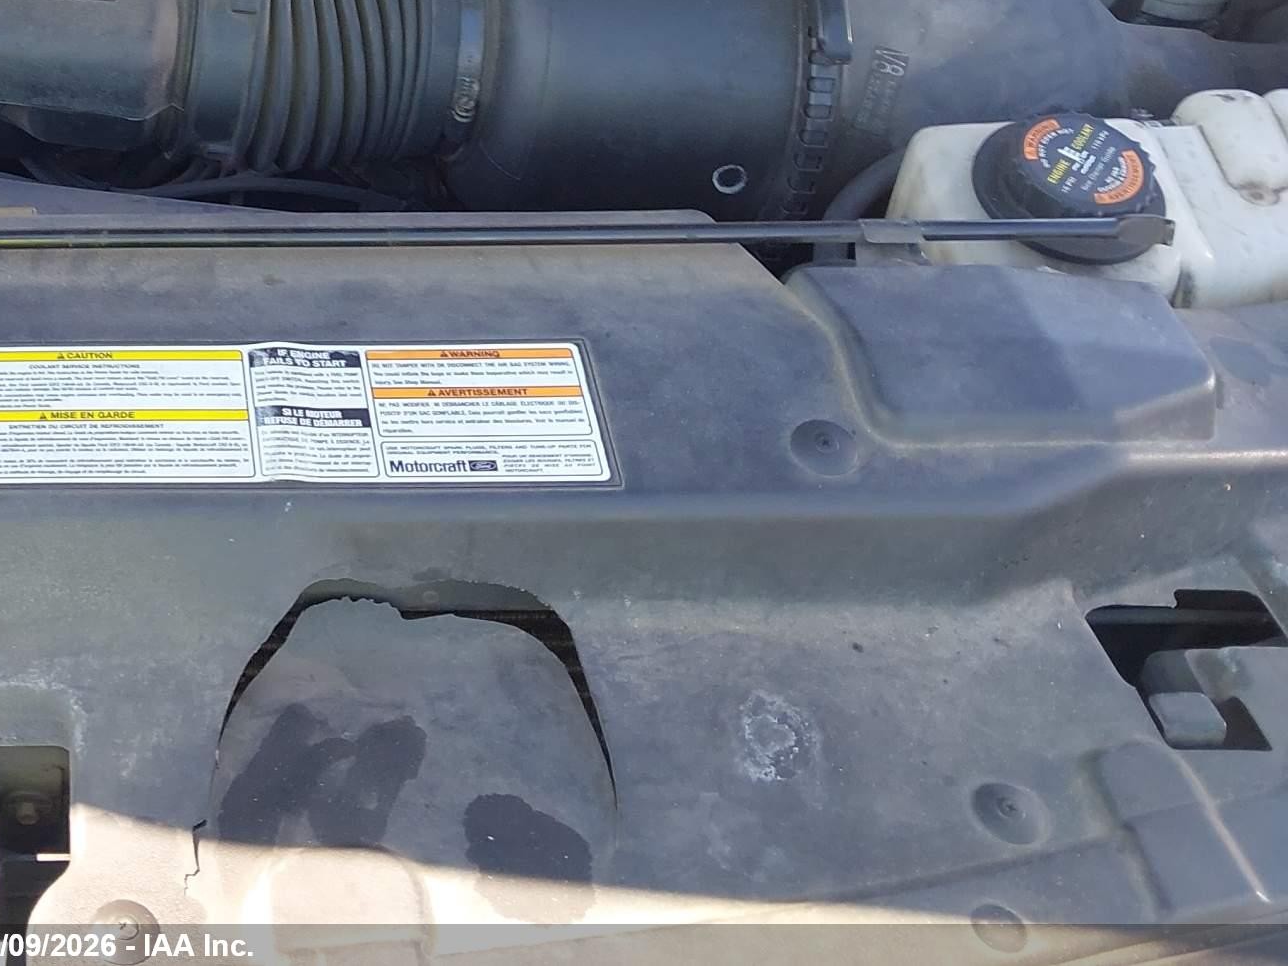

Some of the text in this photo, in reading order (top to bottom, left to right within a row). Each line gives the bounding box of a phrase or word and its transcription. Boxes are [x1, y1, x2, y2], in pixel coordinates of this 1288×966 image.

[874, 47, 907, 77] V8
[1047, 123, 1094, 185] ENGINE COOLANT
[290, 350, 330, 359] ENGINE
[450, 350, 500, 358] WARNING
[262, 357, 293, 365] FAILS
[294, 358, 310, 366] TO
[50, 411, 136, 419] MISE EN GARDE
[282, 408, 342, 418] SI LE MOTEUR
[263, 416, 298, 425] REFUSE
[390, 460, 468, 473] Motorcraft
